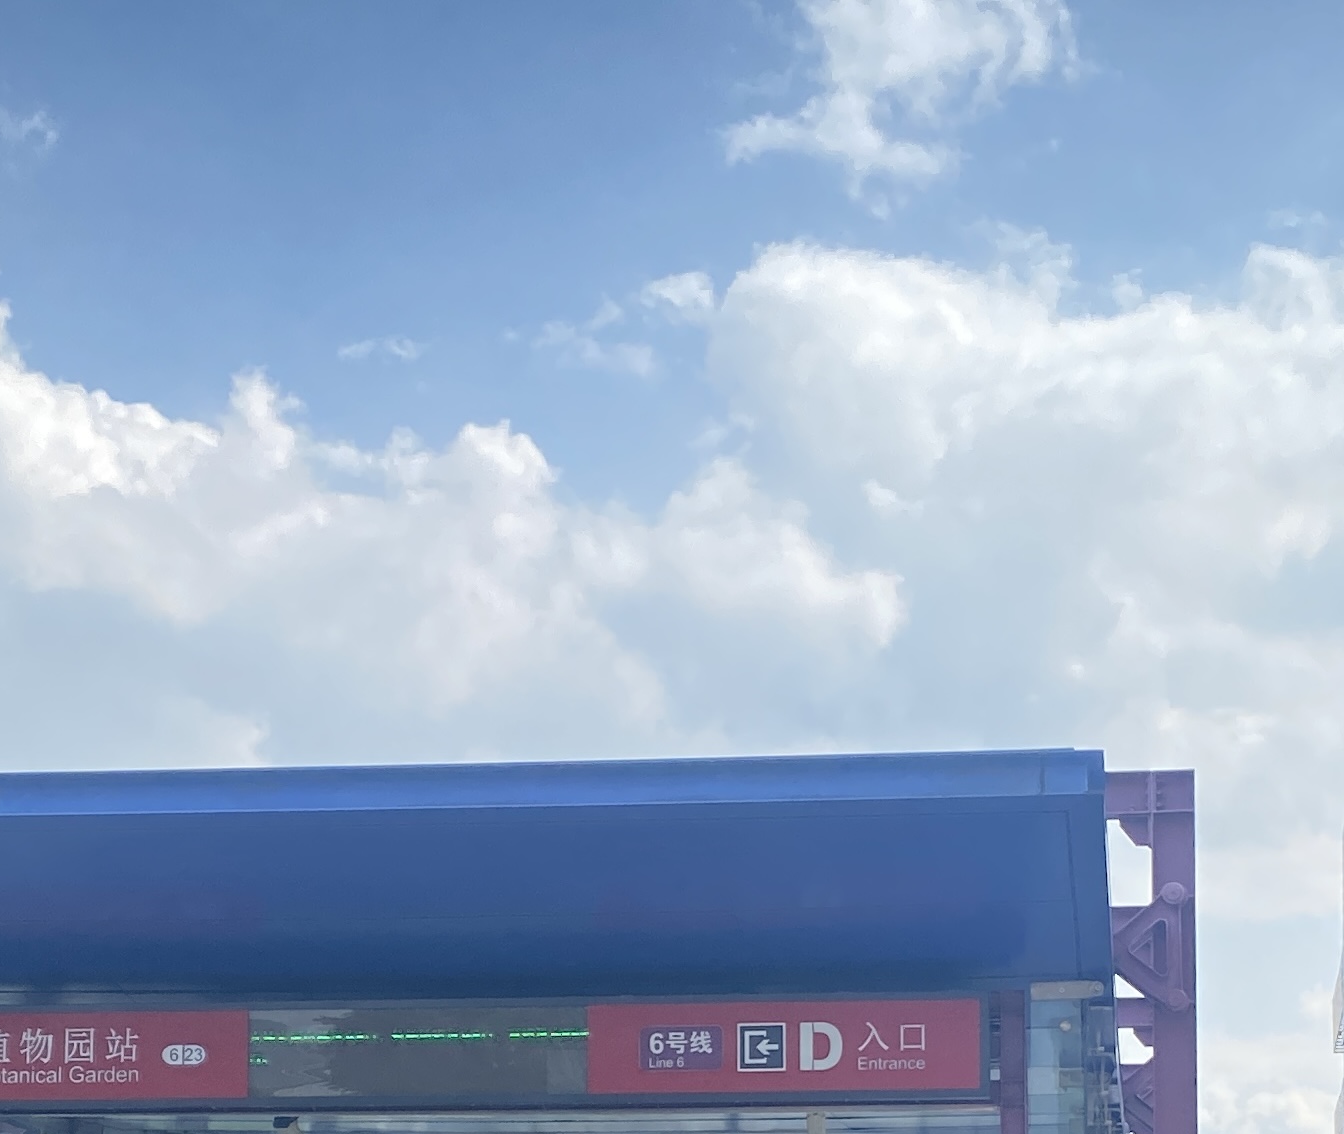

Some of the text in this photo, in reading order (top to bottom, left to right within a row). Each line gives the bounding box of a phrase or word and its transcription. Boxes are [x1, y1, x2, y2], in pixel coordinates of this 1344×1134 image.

[648, 1031, 712, 1055] 6号线
[857, 1021, 926, 1052] 入口
[799, 1021, 843, 1071] D
[184, 1047, 203, 1064] 23
[648, 1056, 685, 1069] Line 6
[857, 1056, 926, 1071] Entrance
[69, 1066, 140, 1084] Garden
